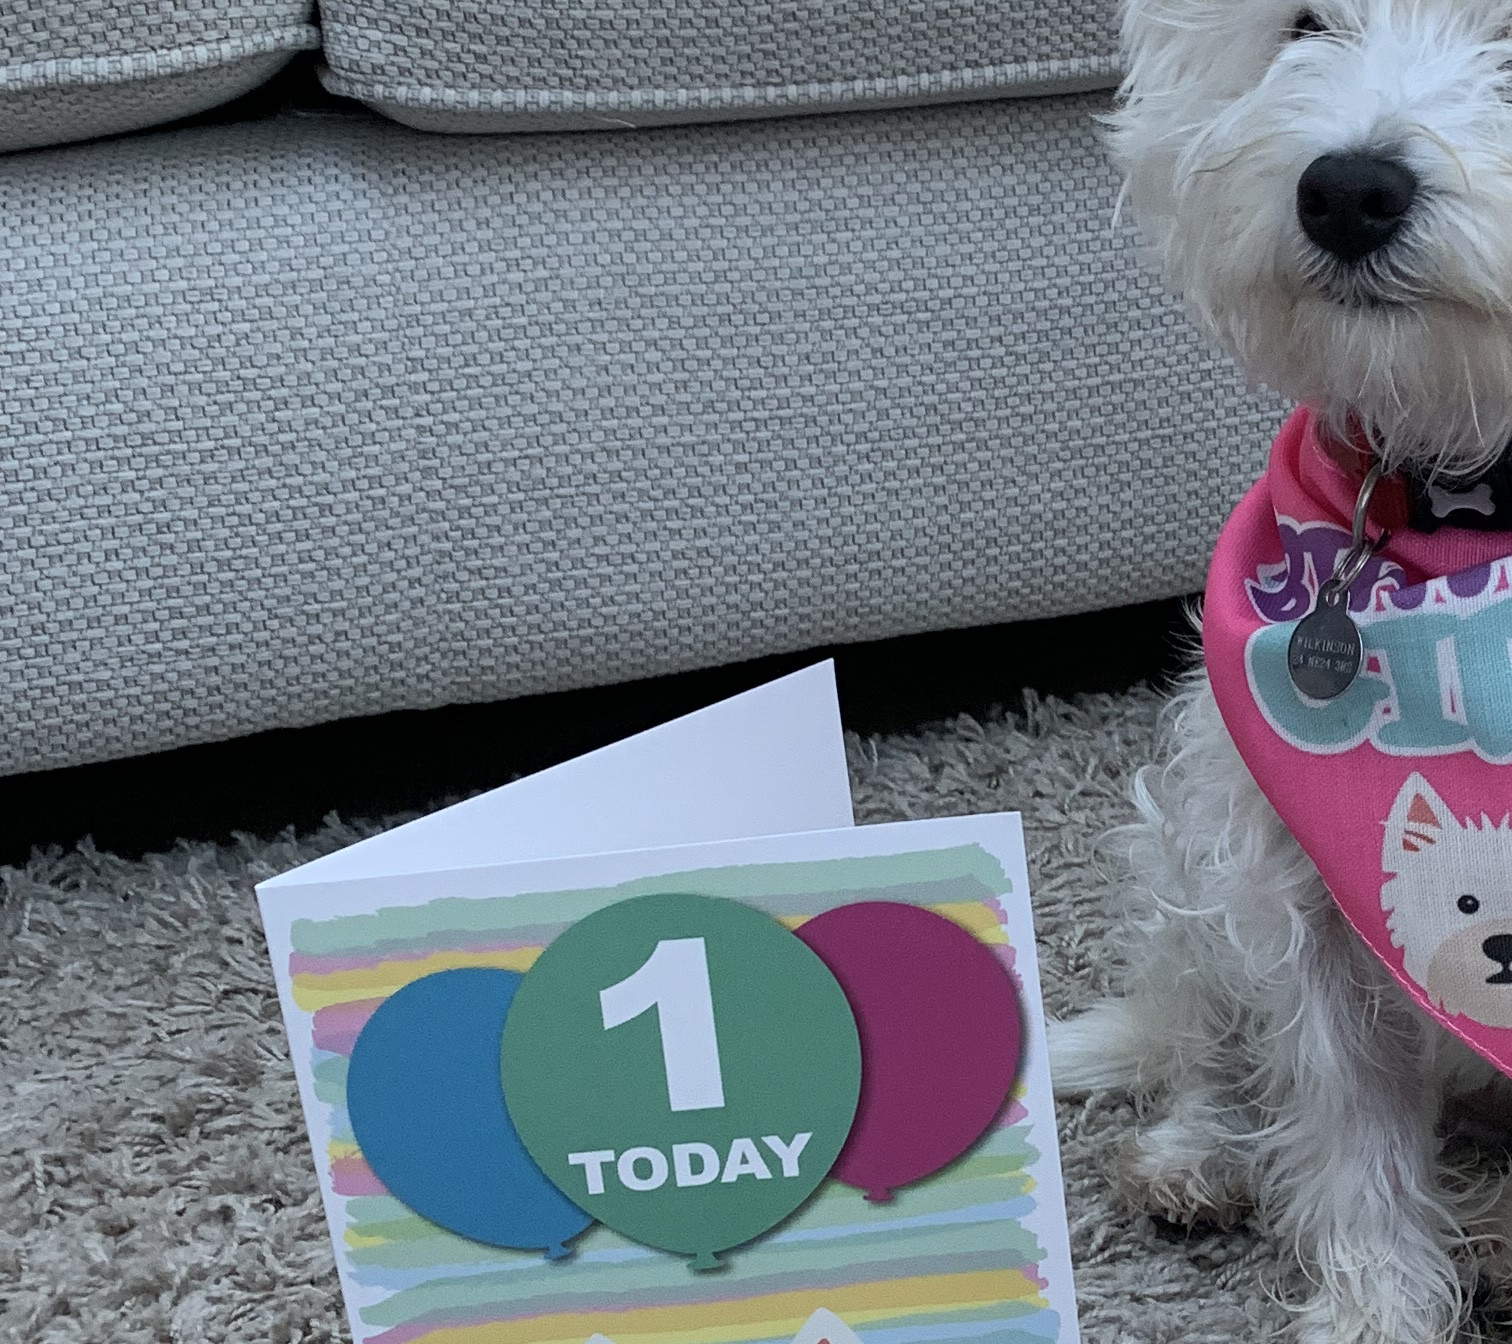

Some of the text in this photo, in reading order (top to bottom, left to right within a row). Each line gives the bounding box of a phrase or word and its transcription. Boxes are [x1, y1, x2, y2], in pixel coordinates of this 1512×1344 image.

[1297, 636, 1356, 656] WILKINSON
[599, 936, 726, 1112] 1
[567, 1131, 813, 1195] TODAY
